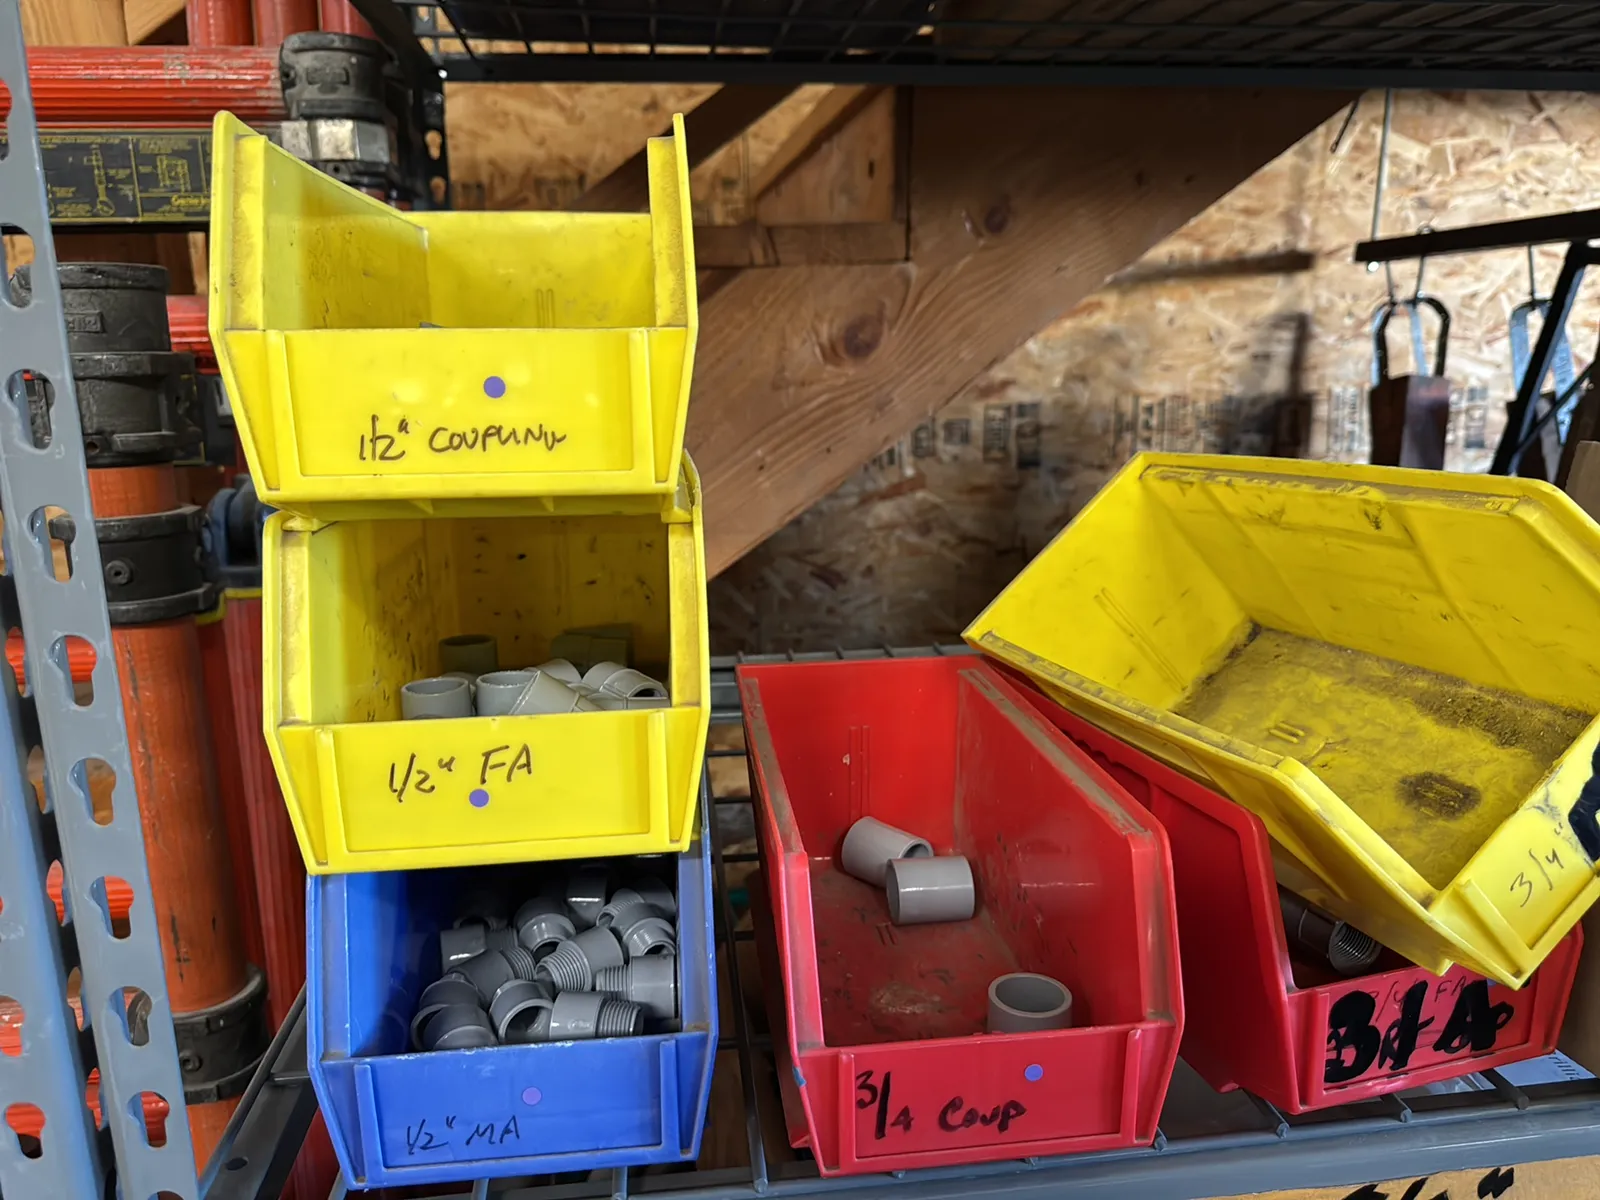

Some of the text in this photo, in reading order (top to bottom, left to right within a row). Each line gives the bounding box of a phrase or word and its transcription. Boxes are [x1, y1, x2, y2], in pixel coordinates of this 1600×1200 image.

[388, 743, 533, 803] 1/2" FA
[406, 1114, 520, 1156] 1/2" MA
[855, 1070, 914, 1140] 3/4
